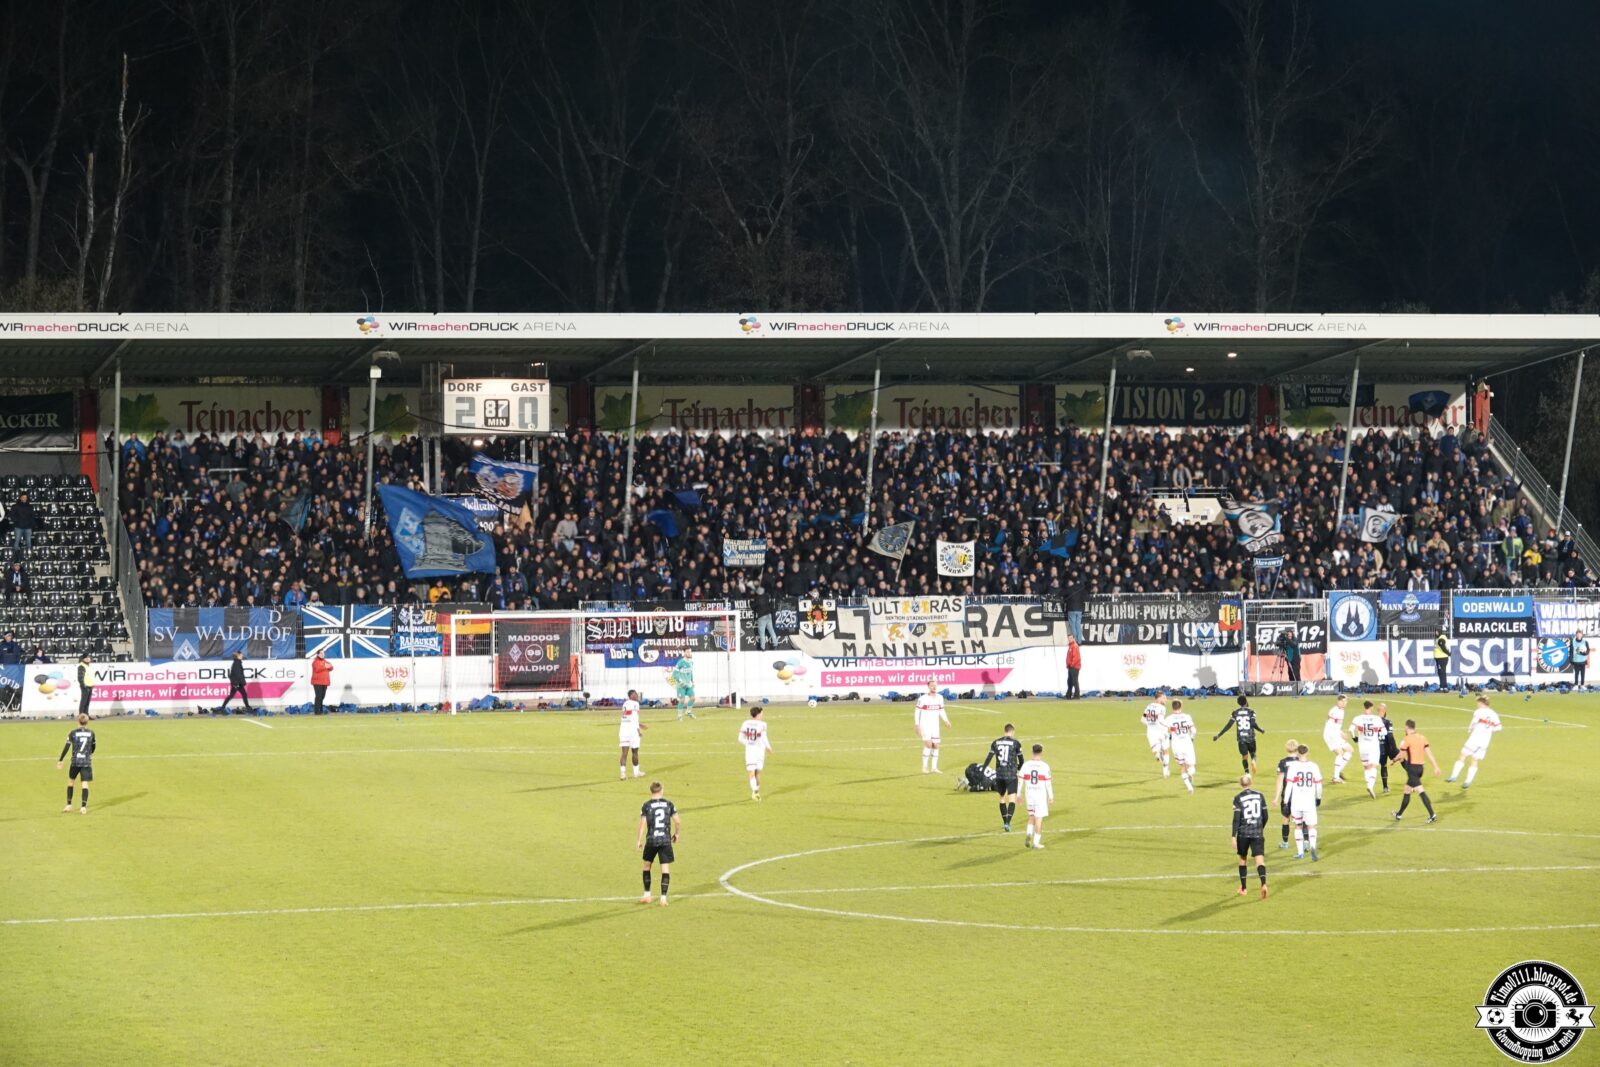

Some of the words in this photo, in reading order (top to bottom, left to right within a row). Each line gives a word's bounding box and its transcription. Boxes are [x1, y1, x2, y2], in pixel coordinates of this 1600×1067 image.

[0, 322, 130, 332] WIRmachenDRUCK
[133, 322, 190, 332] ARENA
[388, 322, 520, 331] WIRmachenDRUCK
[523, 322, 577, 331] ARENA
[769, 322, 896, 331] WIRmachenDRUCK
[898, 322, 950, 331] ARENA
[1193, 322, 1314, 331] WIRmachenDRUCK
[1316, 322, 1368, 331] ARENA
[447, 382, 483, 392] DORF
[510, 382, 546, 392] GAST
[178, 400, 312, 434] Teinacher
[455, 396, 476, 430] 2
[485, 400, 508, 418] 87
[518, 396, 539, 430] 0
[665, 398, 795, 430] Teinacher
[892, 397, 1018, 429] Teinacher
[487, 418, 507, 426] MIN
[1462, 602, 1525, 613] ODENWALD
[154, 626, 179, 642] SV
[195, 625, 292, 642] WALDHOF
[1459, 621, 1527, 633] BARACKLER
[507, 634, 561, 642] MADDOGS
[841, 638, 987, 658] MANNHEIM
[508, 664, 561, 672] WALDHOF
[825, 673, 842, 684] Sie
[844, 673, 885, 685] sparen,
[887, 672, 904, 683] wir
[907, 671, 956, 684] drucken!
[91, 688, 108, 699] Sie
[112, 689, 155, 701] sparen,
[158, 686, 177, 697] wir
[181, 684, 231, 697] drucken!
[1235, 716, 1251, 730] 36
[1363, 723, 1375, 737] 15
[79, 737, 88, 752] 7
[997, 745, 1010, 762] 31
[1030, 769, 1039, 785] 8
[1296, 771, 1313, 788] 38
[1243, 799, 1261, 818] 20
[654, 808, 666, 828] 2
